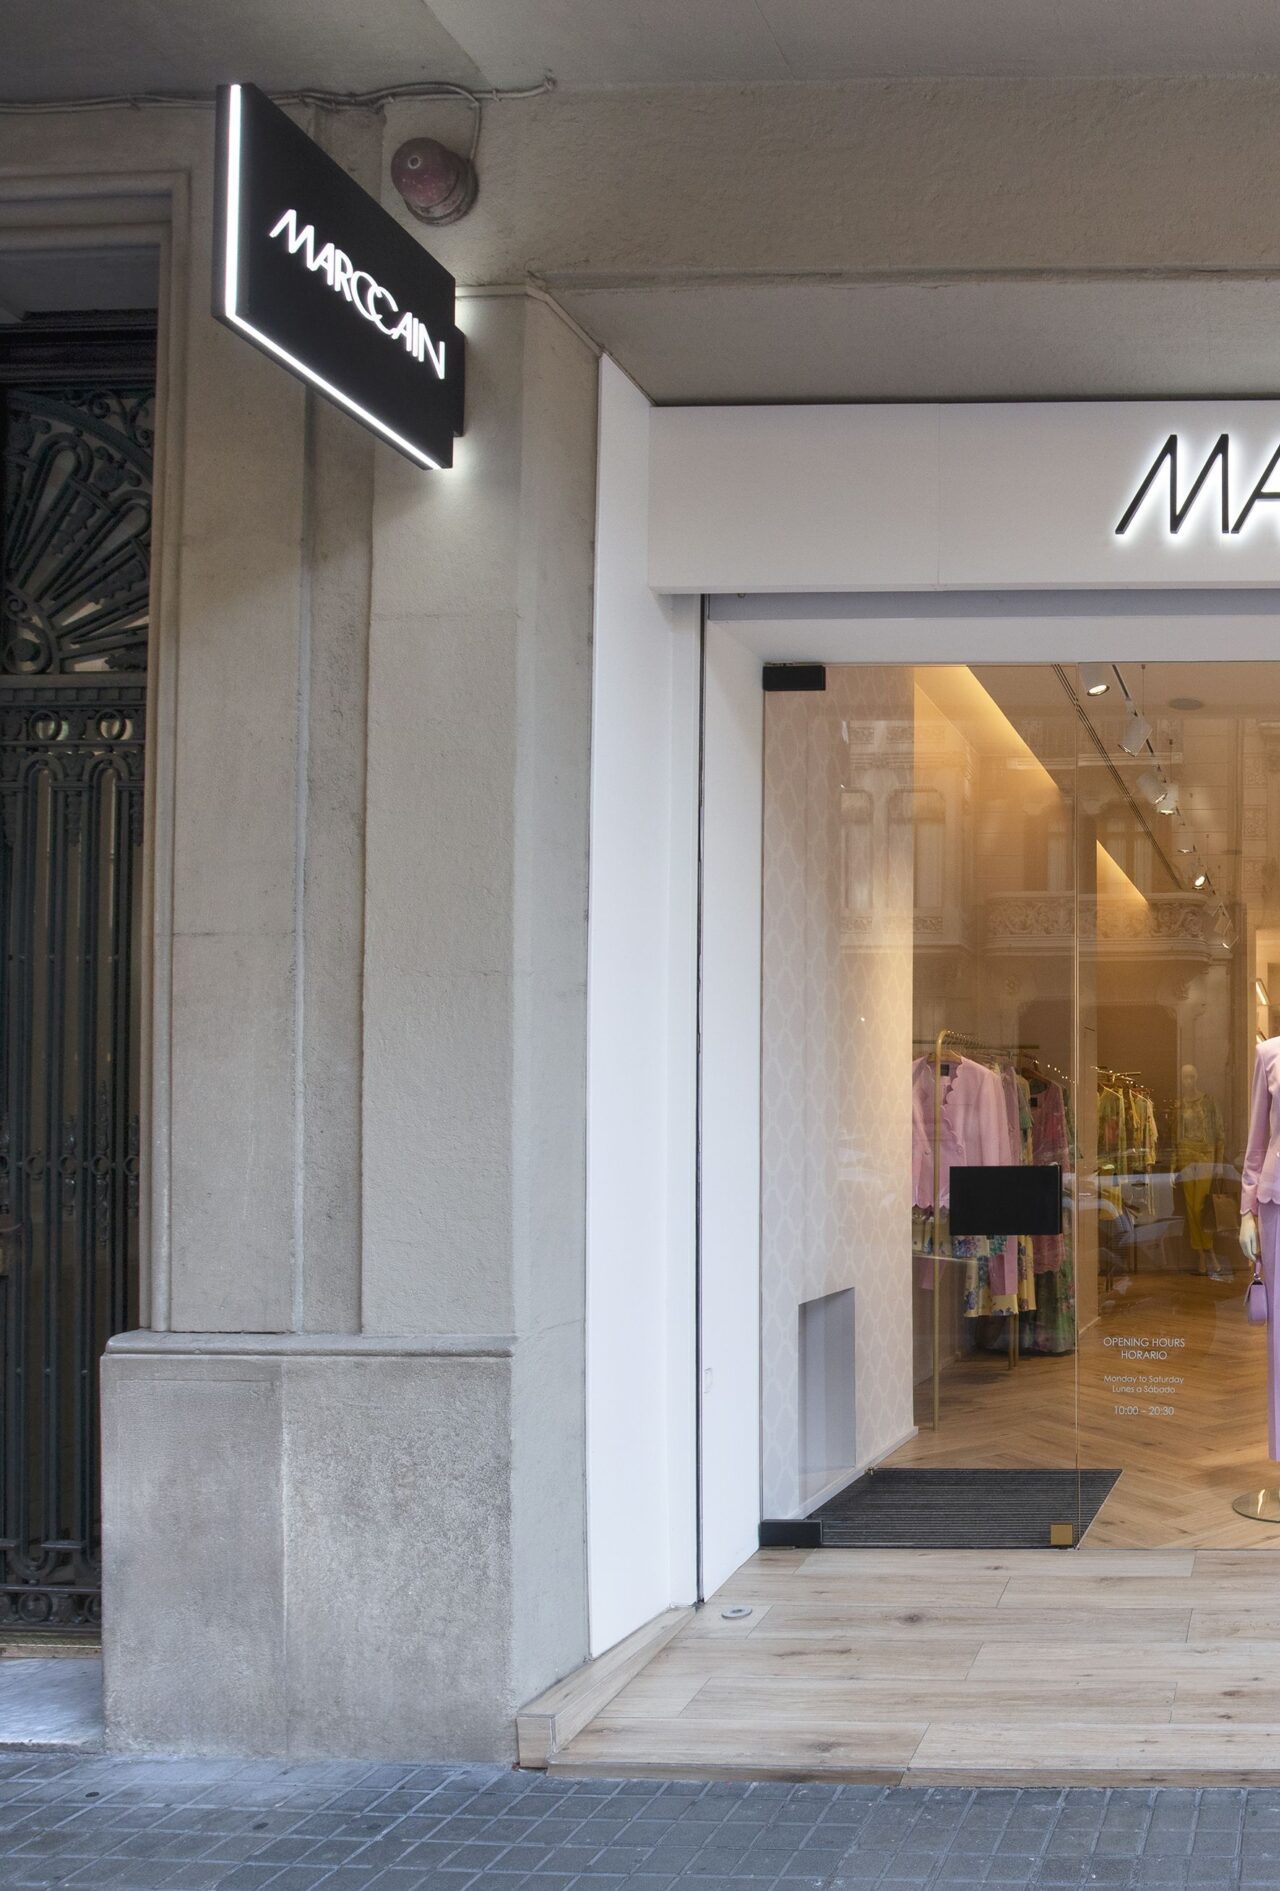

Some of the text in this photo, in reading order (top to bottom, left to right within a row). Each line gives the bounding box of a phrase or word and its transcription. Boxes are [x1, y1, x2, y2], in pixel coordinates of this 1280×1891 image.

[1103, 1337, 1185, 1348] OPENING HOURS
[1121, 1350, 1168, 1360] HORARIO
[1104, 1375, 1184, 1384] Monday to Saturday
[1112, 1384, 1135, 1393] Lunes
[1114, 1405, 1139, 1415] 10:00
[1148, 1406, 1175, 1416] 20:30
